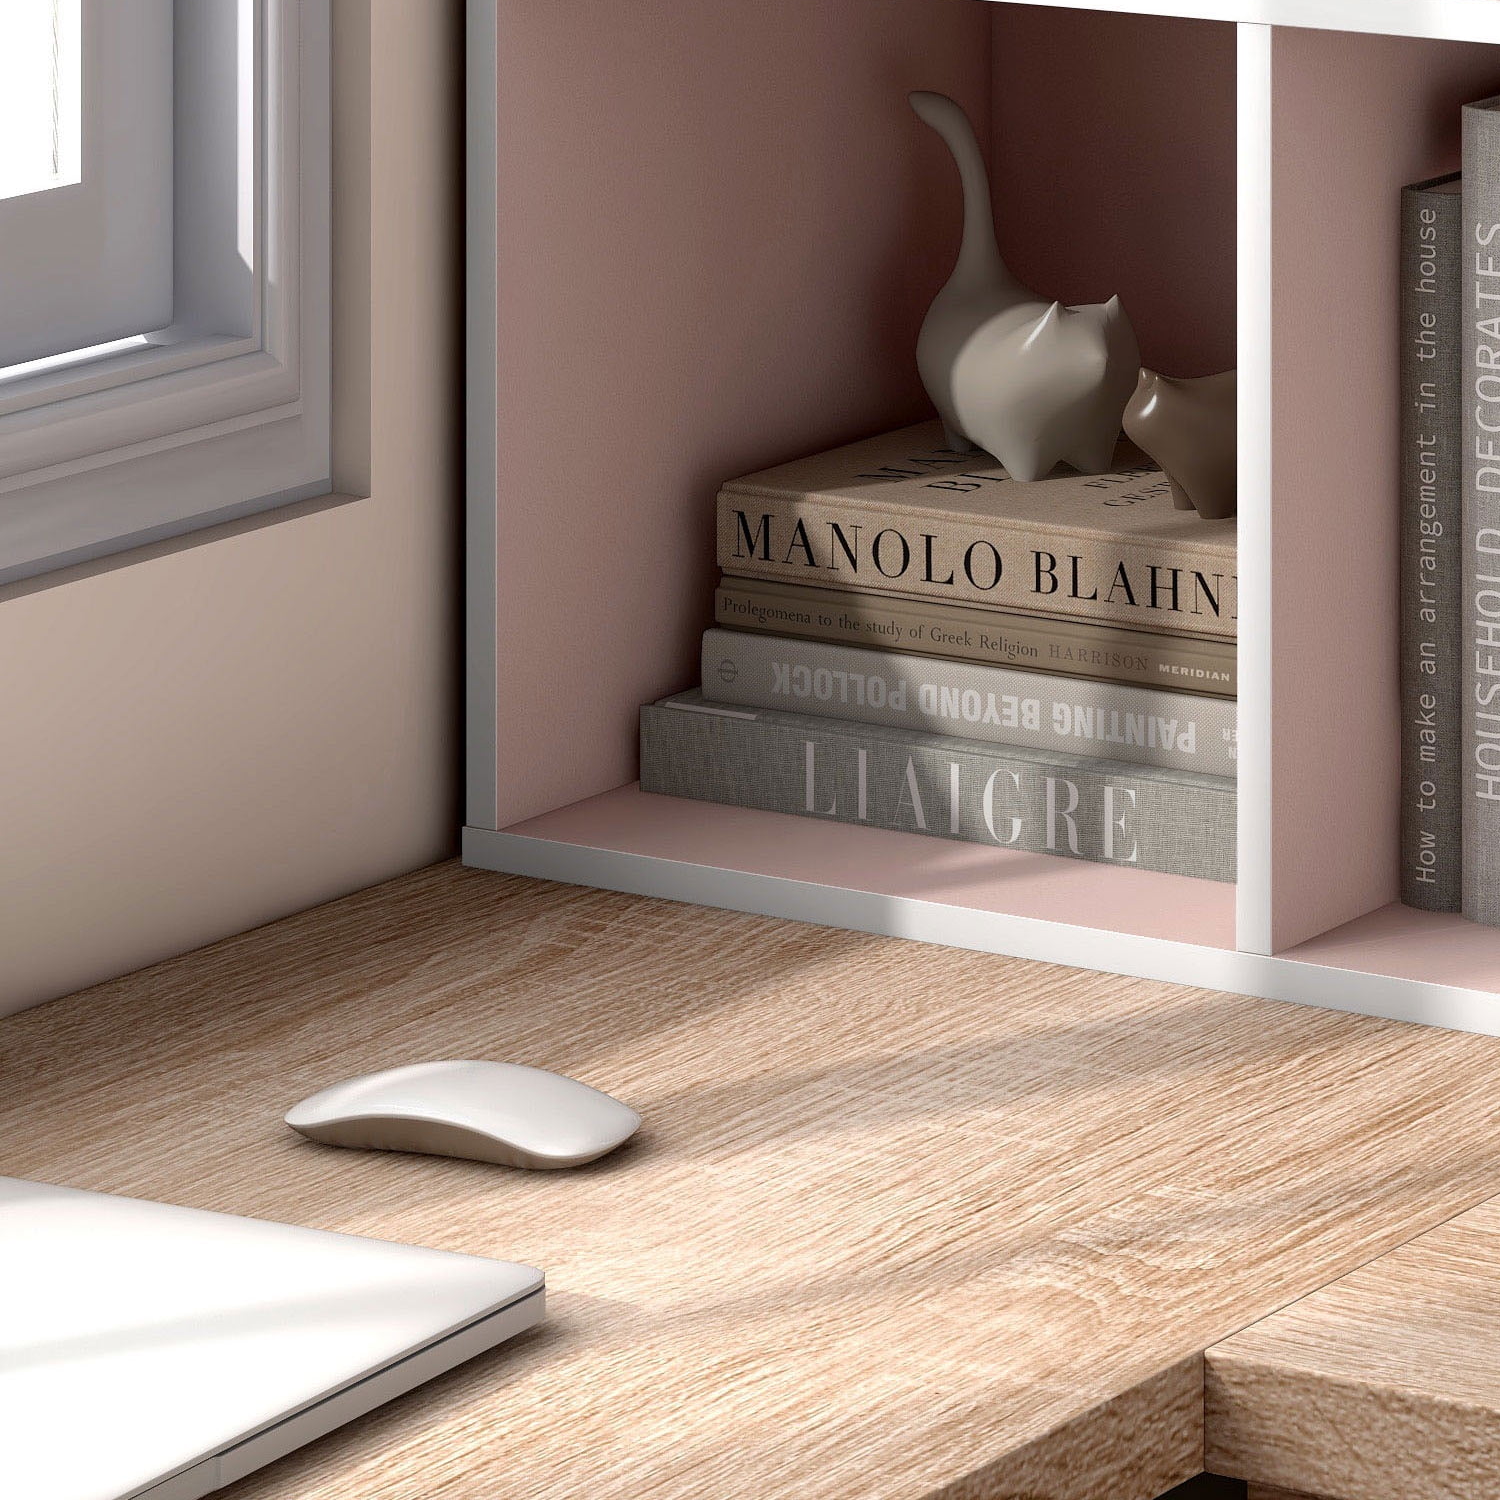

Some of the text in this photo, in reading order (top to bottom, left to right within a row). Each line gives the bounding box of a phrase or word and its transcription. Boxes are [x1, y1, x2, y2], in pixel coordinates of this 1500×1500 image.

[732, 509, 1003, 591] MANOLO
[1414, 208, 1443, 884] How to make an arrangement in the house
[722, 597, 1039, 660] Prolegomena to the study of Greek Religion
[1049, 643, 1149, 671] HARRISON
[771, 661, 1196, 754] PAINTING BEYOND POLLOCK
[1159, 664, 1231, 682] MERIDIAN
[802, 740, 1138, 863] LIAIGRE
